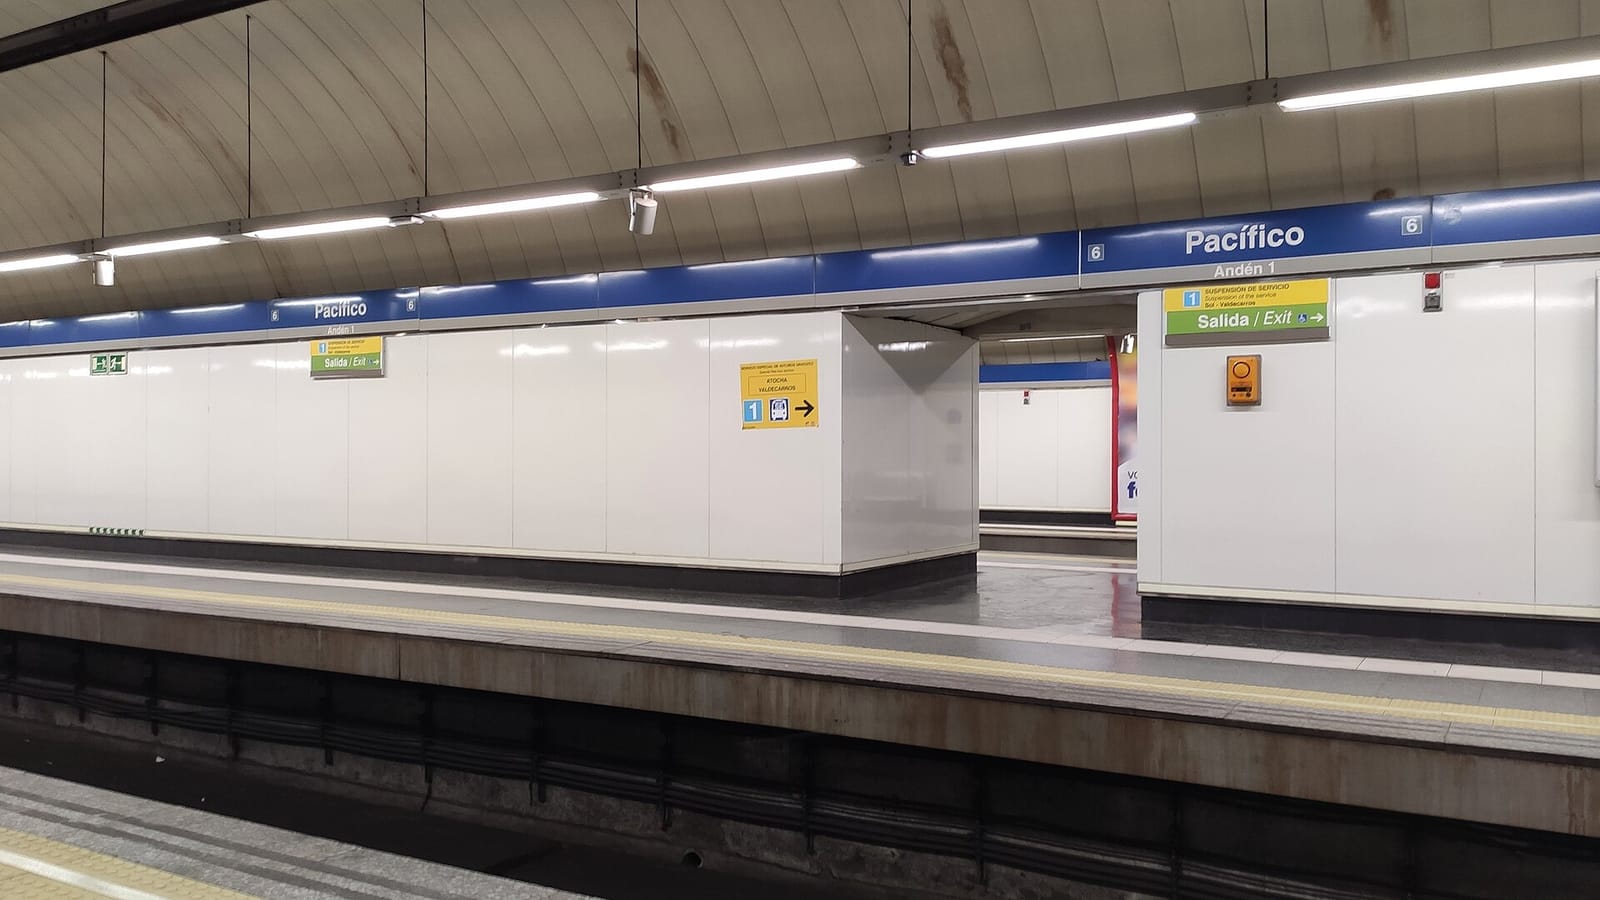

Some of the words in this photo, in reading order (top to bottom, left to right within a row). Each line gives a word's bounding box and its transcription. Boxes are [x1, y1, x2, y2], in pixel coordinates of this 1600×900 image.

[1406, 218, 1417, 232] 6
[1186, 223, 1304, 254] Pacífico
[1092, 246, 1100, 259] 6
[1214, 263, 1263, 278] Andén
[1268, 261, 1276, 274] 1
[408, 300, 413, 310] 6
[1188, 292, 1196, 306] 1
[272, 311, 278, 320] 6
[315, 300, 367, 318] Pacífico
[1198, 312, 1249, 329] Salida
[1254, 312, 1260, 327] /
[1264, 310, 1293, 326] Exit
[324, 358, 348, 368] Salida
[353, 357, 366, 366] Exit
[749, 402, 757, 420] 1
